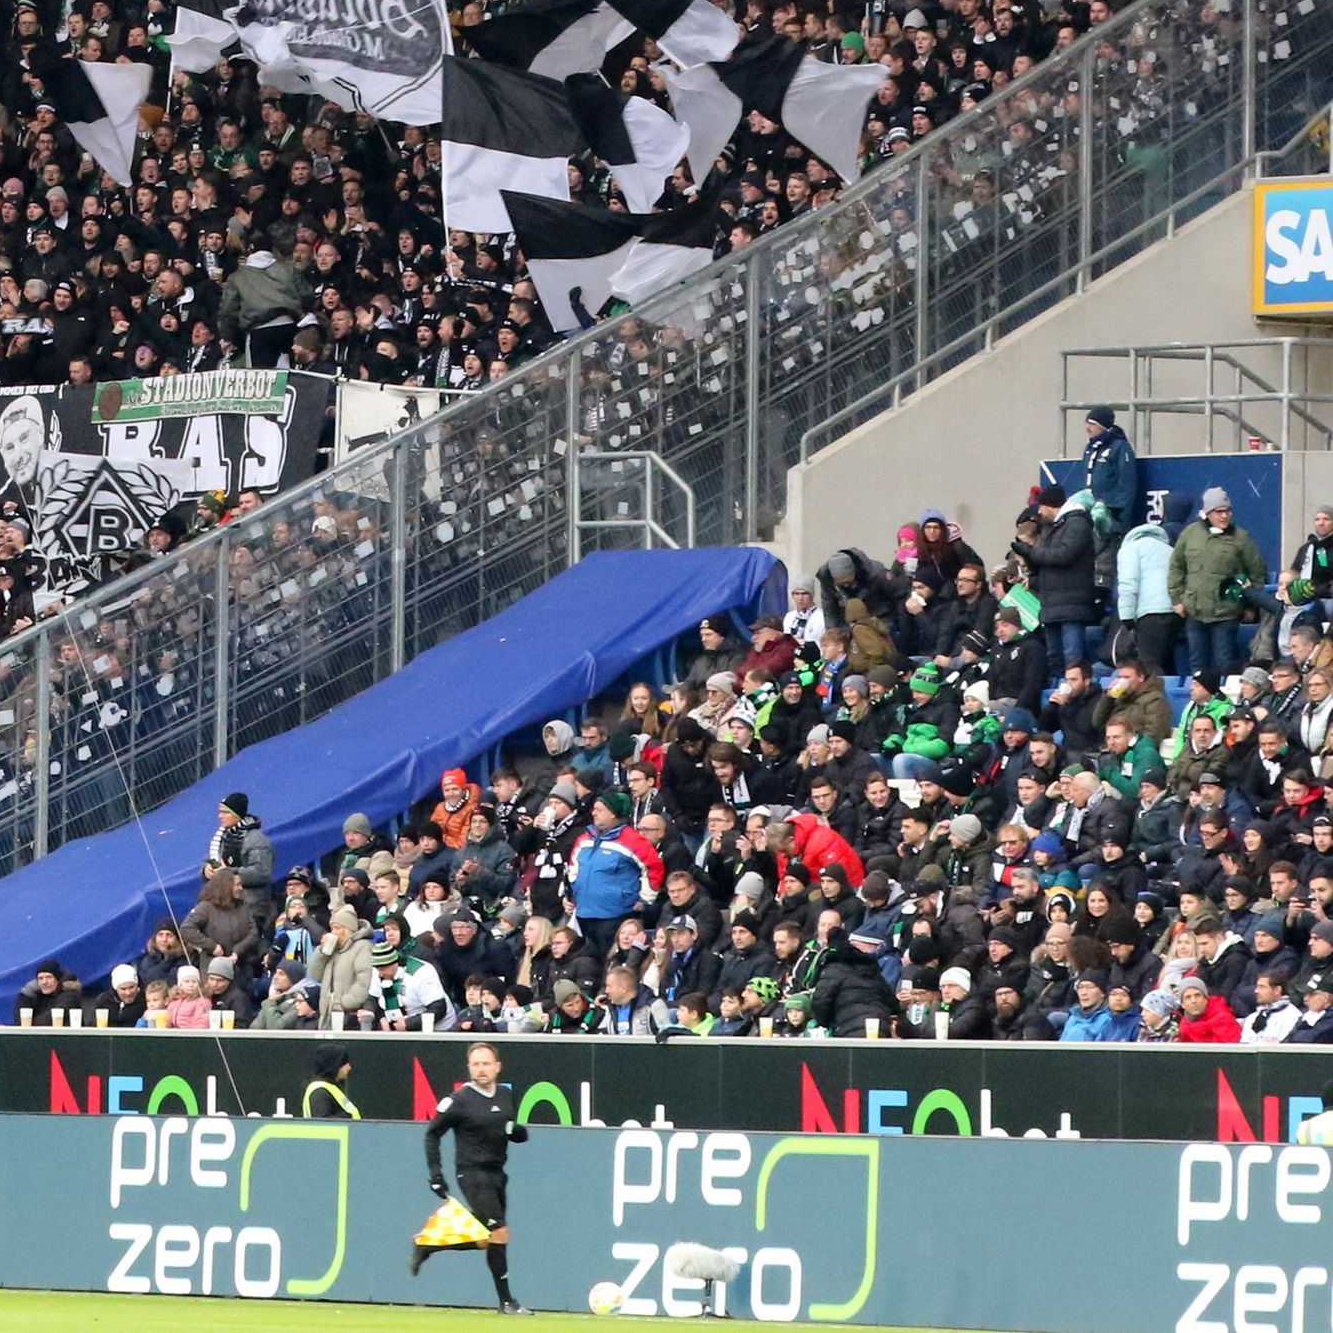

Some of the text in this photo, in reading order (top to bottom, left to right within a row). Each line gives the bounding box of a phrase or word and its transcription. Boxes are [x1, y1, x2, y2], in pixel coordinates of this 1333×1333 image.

[141, 371, 276, 404] STADIONVERBOT
[110, 1115, 236, 1209] pre
[612, 1130, 752, 1227] pre
[1177, 1143, 1332, 1246] pre
[108, 1223, 282, 1298] zero
[1175, 1262, 1333, 1333] zer
